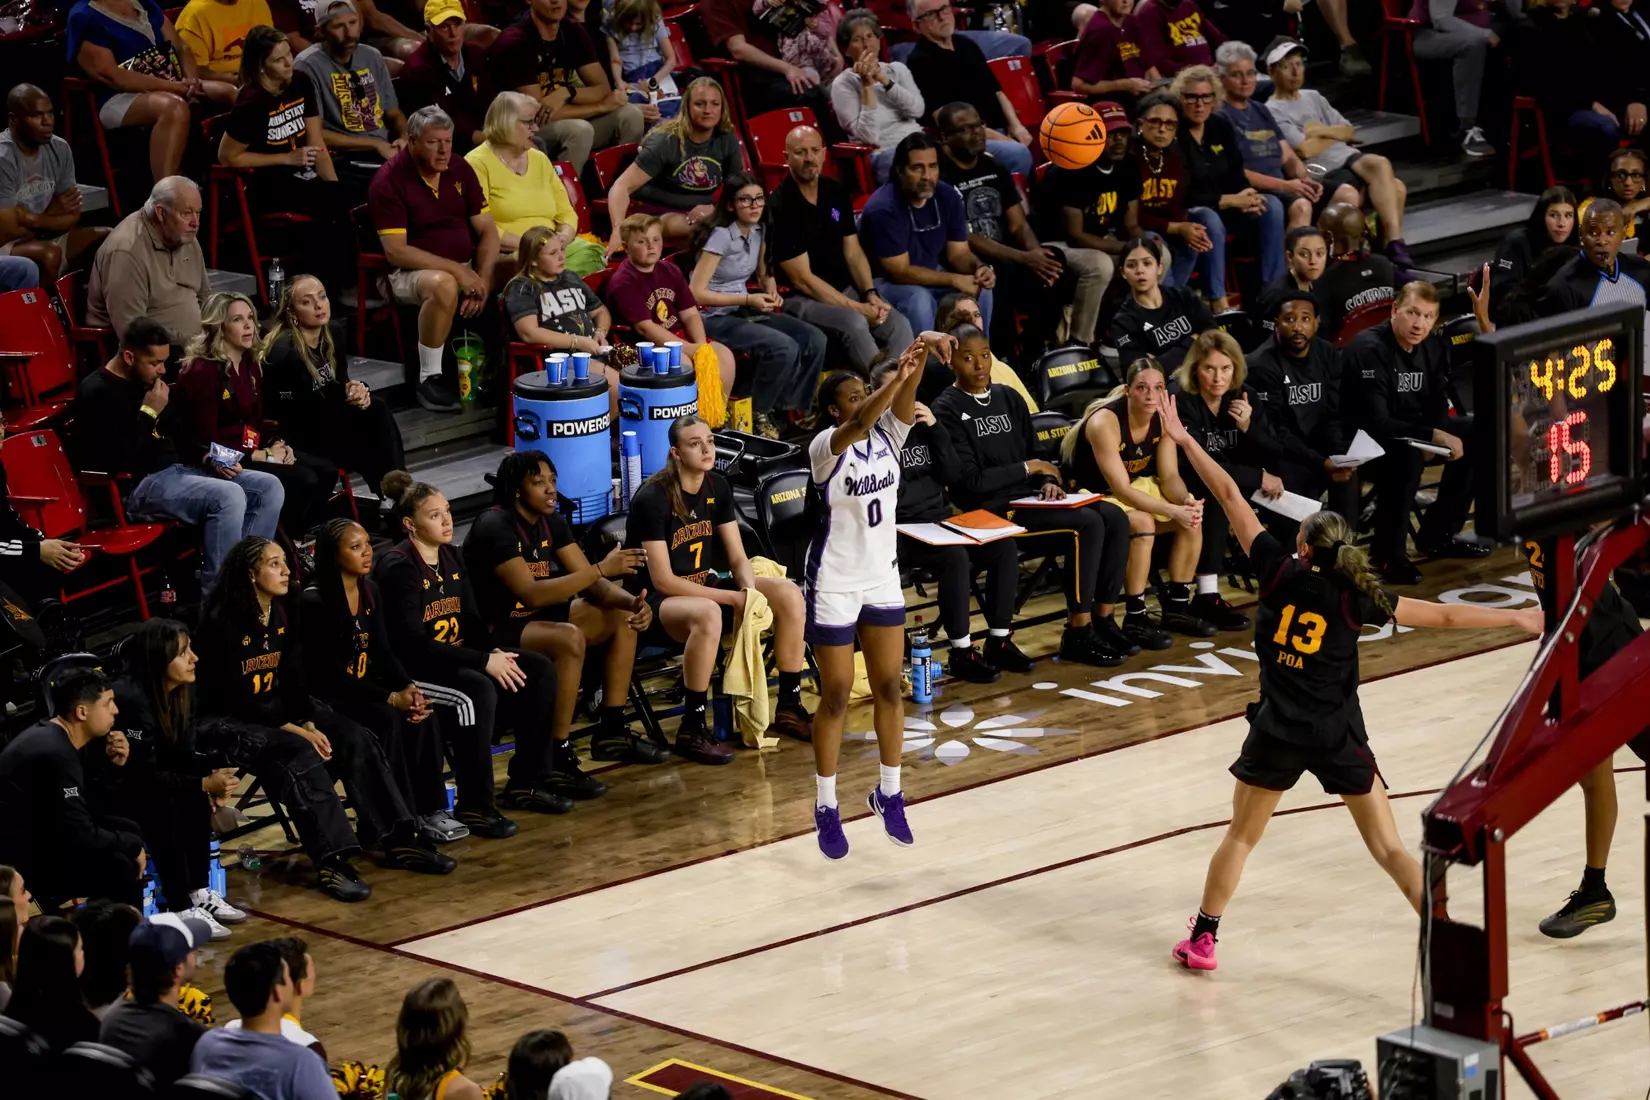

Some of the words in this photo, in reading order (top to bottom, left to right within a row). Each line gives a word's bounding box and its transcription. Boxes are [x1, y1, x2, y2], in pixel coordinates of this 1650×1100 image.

[540, 287, 587, 322] ASU
[1153, 315, 1193, 347] ASU
[1047, 364, 1078, 379] ARIZONA
[1077, 359, 1101, 374] STATE
[1397, 372, 1424, 393] ASU
[1530, 338, 1617, 401] 4:25
[1288, 383, 1322, 406] ASU
[974, 413, 1013, 437] ASU
[1548, 411, 1591, 484] 15
[770, 488, 802, 505] ARIZONA
[844, 469, 895, 497] Wildcats
[867, 498, 883, 528] 0
[689, 541, 703, 569] 7
[434, 616, 460, 643] 23
[1273, 604, 1328, 655] 13
[1277, 650, 1304, 670] POA
